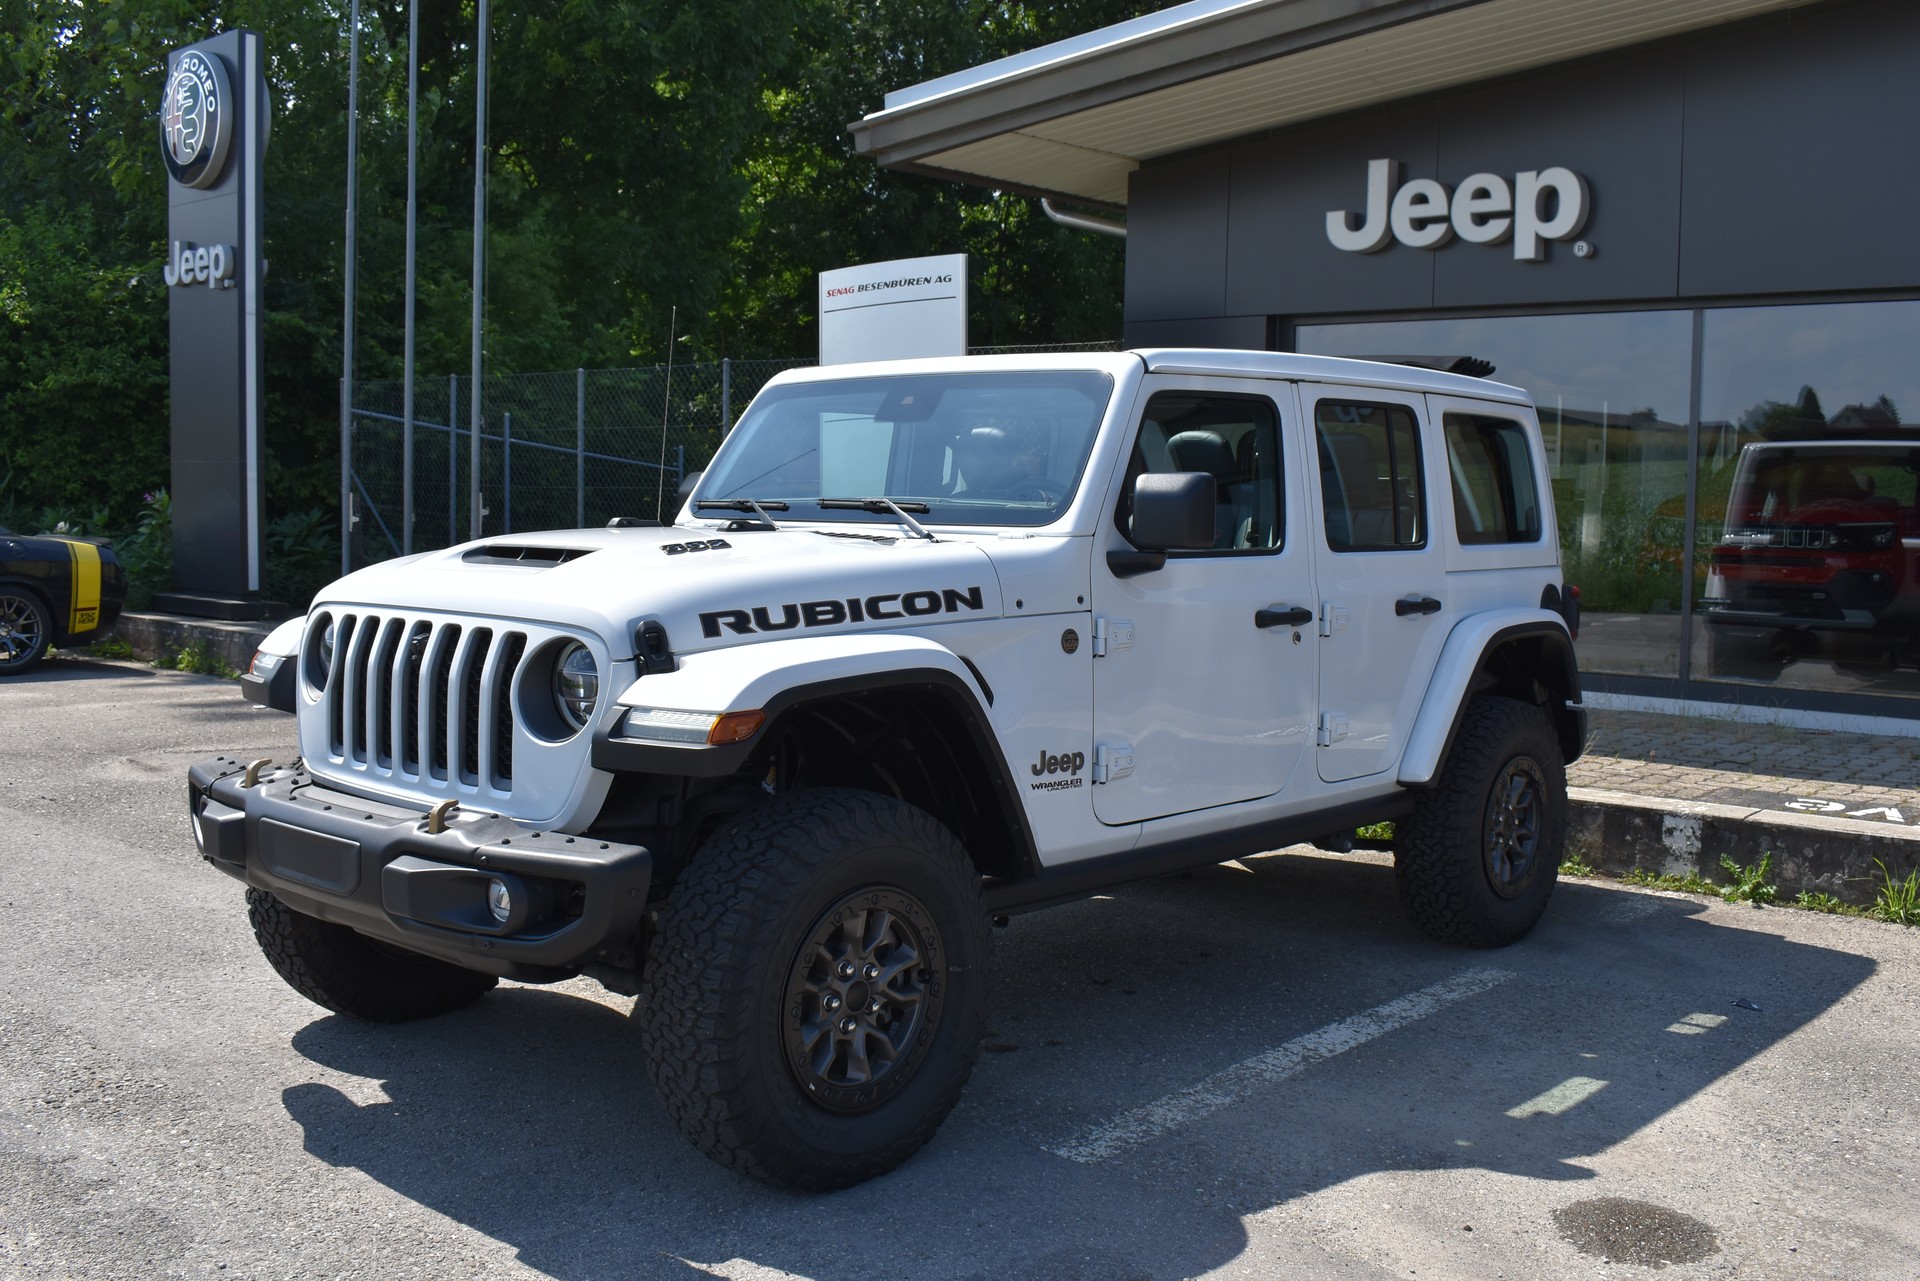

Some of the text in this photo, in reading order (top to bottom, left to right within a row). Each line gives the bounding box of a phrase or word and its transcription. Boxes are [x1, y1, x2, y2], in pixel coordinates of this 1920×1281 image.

[182, 57, 216, 113] ROMEO
[164, 240, 233, 289] Jeep
[826, 274, 952, 298] SENAG BESENBÜREN AG
[698, 586, 985, 639] RUBICON
[1031, 750, 1085, 776] Jeep
[1031, 778, 1083, 791] WRANGLER
